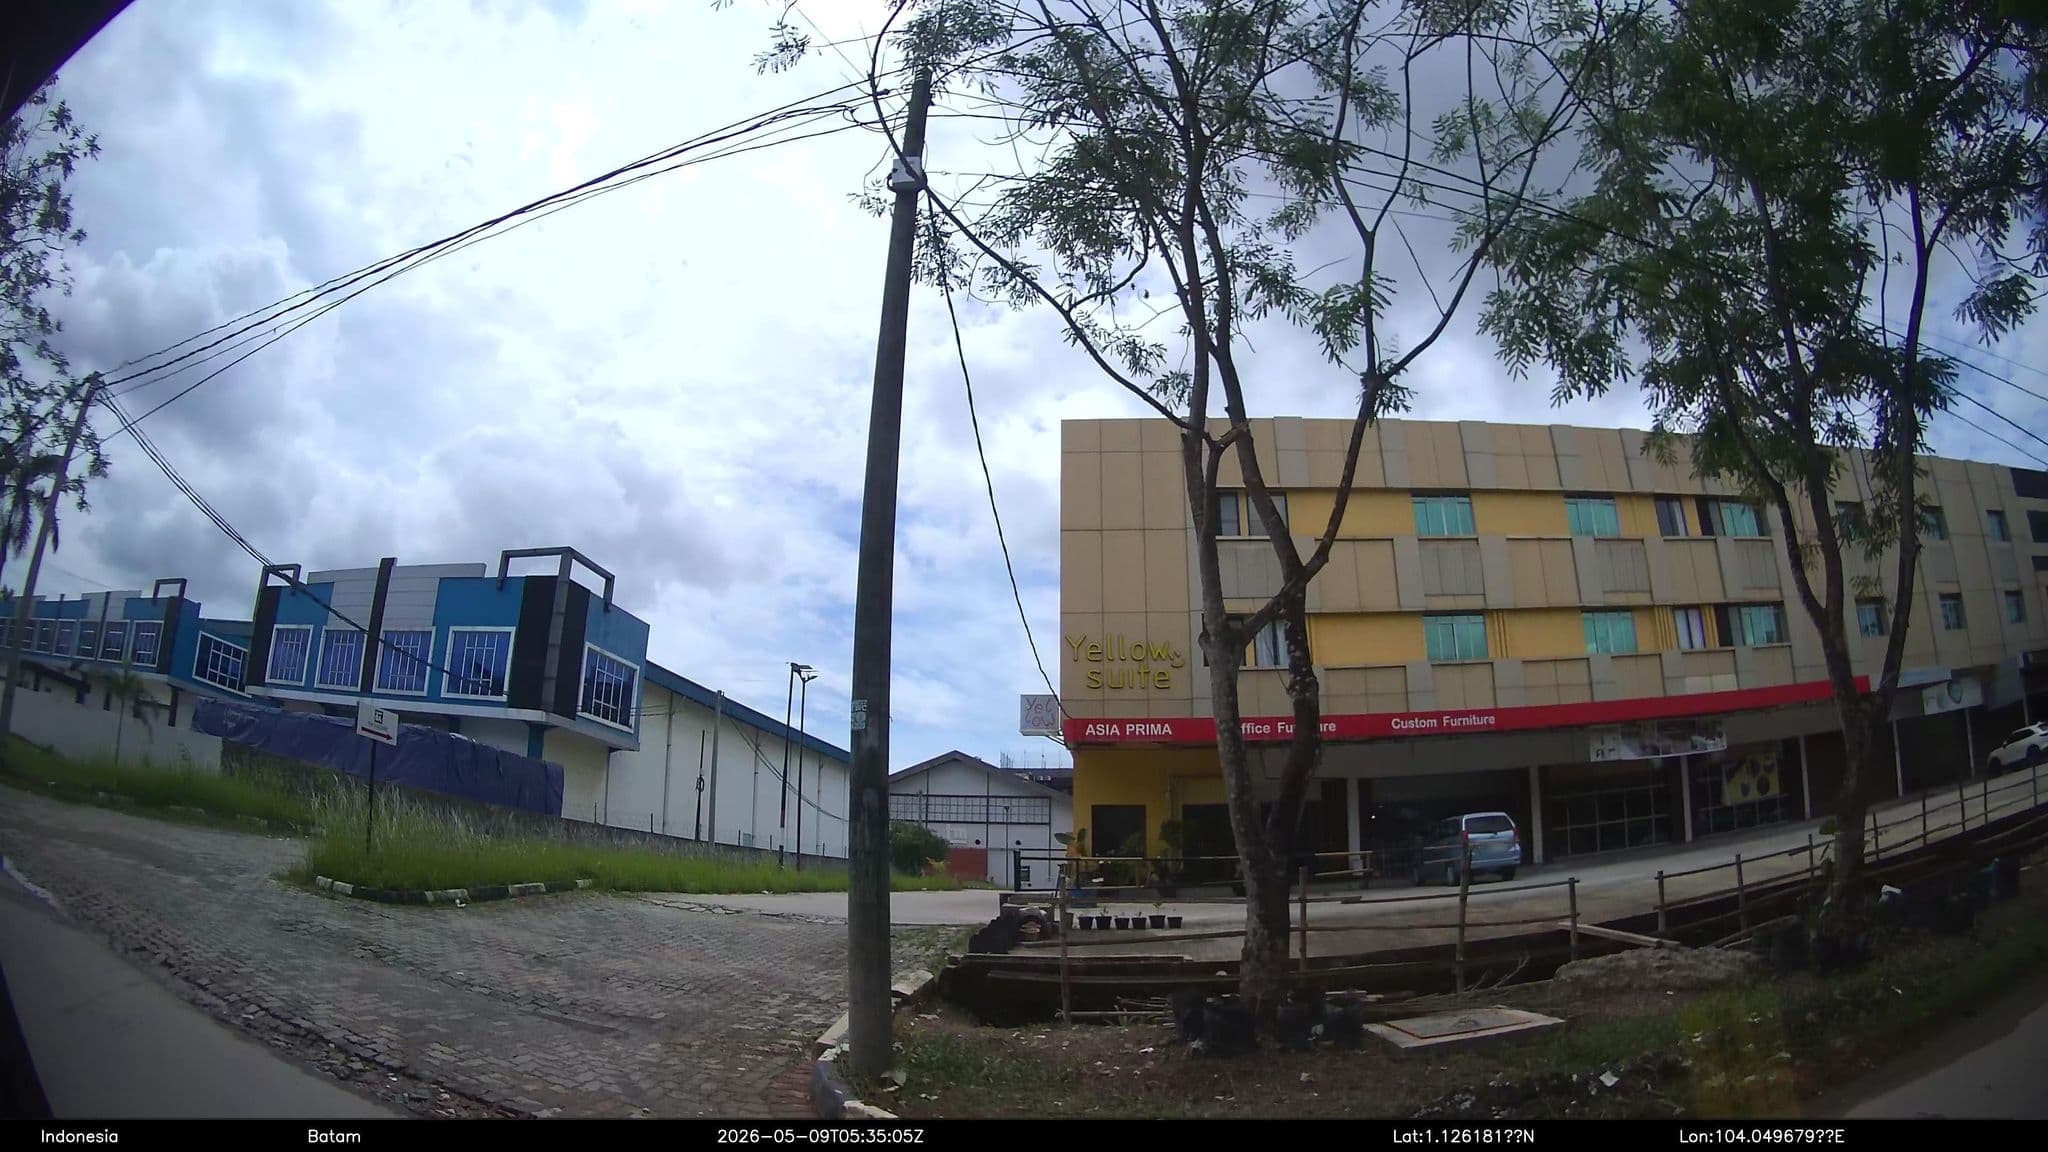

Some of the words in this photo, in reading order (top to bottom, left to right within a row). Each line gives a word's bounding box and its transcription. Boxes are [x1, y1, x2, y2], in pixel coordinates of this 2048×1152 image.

[1065, 631, 1170, 662] Yellow
[1086, 665, 1171, 689] suite
[1240, 722, 1271, 734] ffice
[1391, 717, 1437, 729] Custom
[1442, 714, 1496, 727] Furniture
[1085, 723, 1120, 736] ASIA
[1126, 723, 1173, 736] PRIMA
